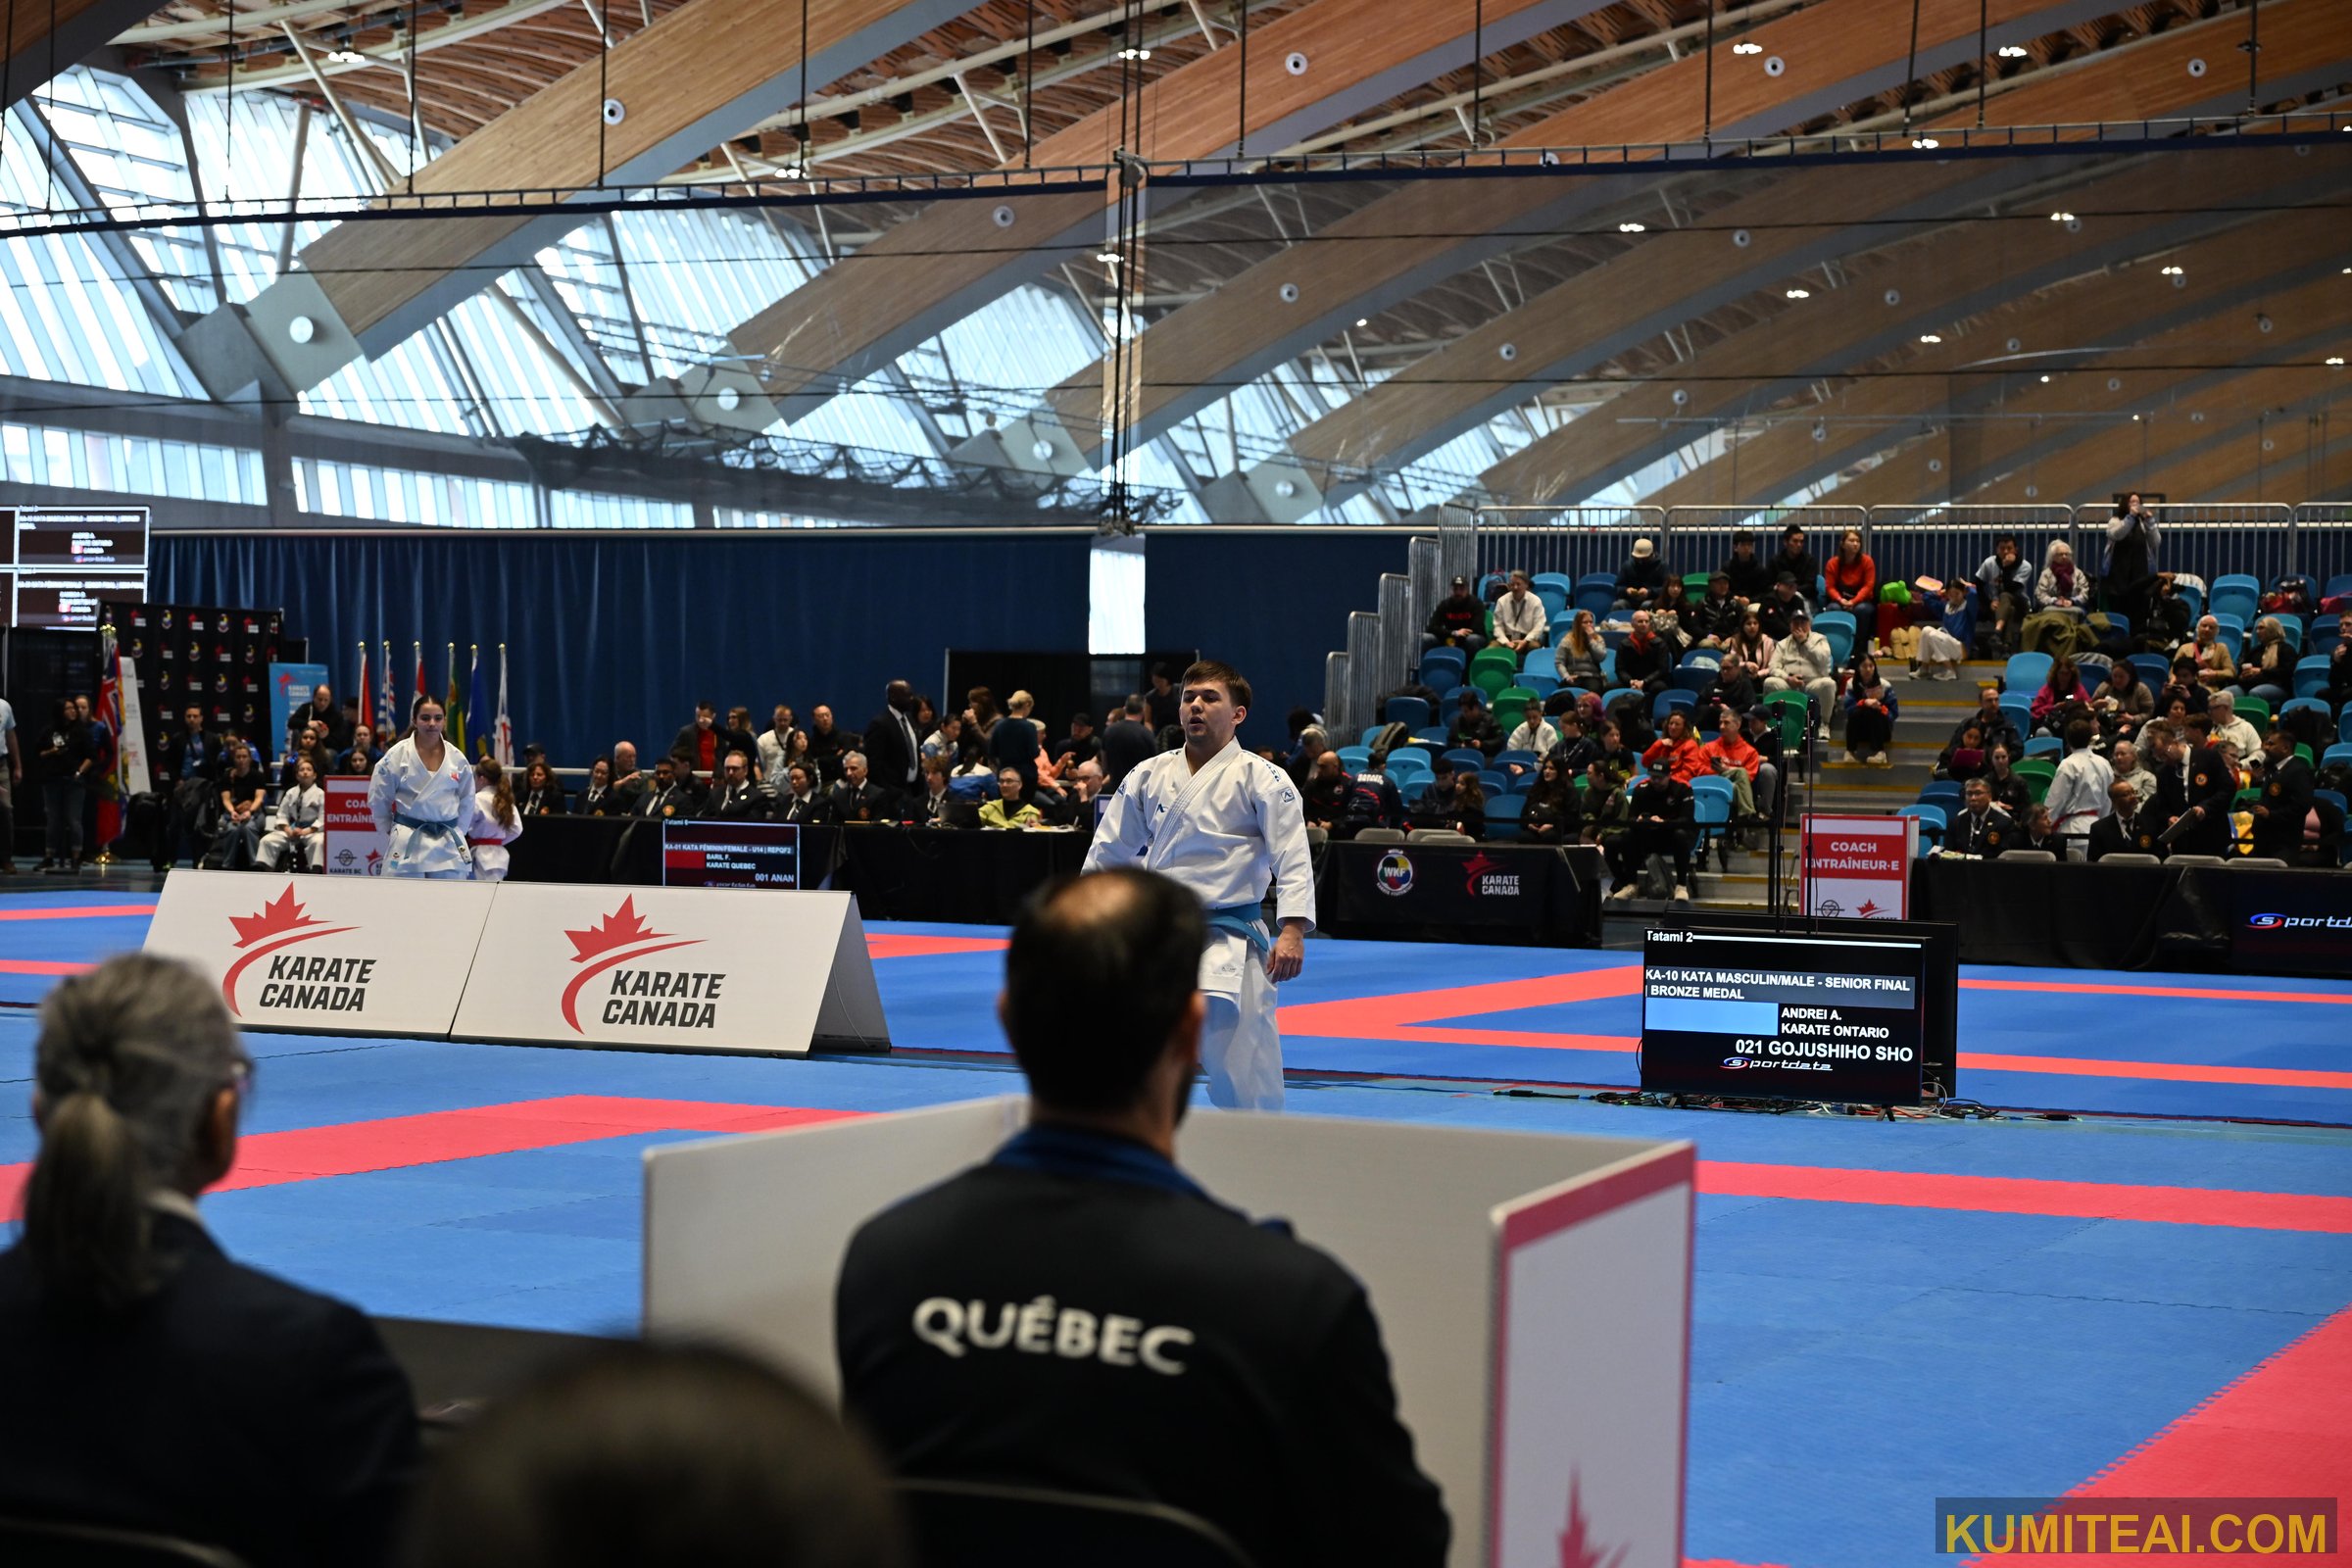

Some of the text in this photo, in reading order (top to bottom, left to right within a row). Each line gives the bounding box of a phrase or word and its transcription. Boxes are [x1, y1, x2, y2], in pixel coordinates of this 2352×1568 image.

[326, 812, 374, 823] ENTRAÎNE
[1831, 842, 1877, 853] COACH
[771, 873, 794, 882] ANAN
[1384, 867, 1407, 877] WKF
[1482, 875, 1519, 885] KARATE
[1482, 885, 1519, 896] CANADA
[1646, 931, 1693, 943] Tatami 2
[268, 956, 377, 984] KARATE
[610, 969, 726, 1000] KARATE
[1645, 969, 1679, 981] KA-10
[1682, 970, 1713, 982] KATA
[1716, 972, 1815, 987] MASCULIN/MALE
[1825, 976, 1872, 990] SENIOR
[1874, 979, 1910, 991] FINAL
[259, 983, 366, 1012] CANADA
[1650, 985, 1700, 998] BRONZE
[1703, 987, 1745, 1000] MEDAL
[602, 999, 715, 1028] CANADA
[1781, 1007, 1842, 1020] ANDREI A.
[1781, 1023, 1889, 1038] KARATE ONTARIO
[1735, 1039, 1913, 1061] 021 GOJUSHIHO SHO
[912, 1295, 1196, 1376] QUÉBEC
